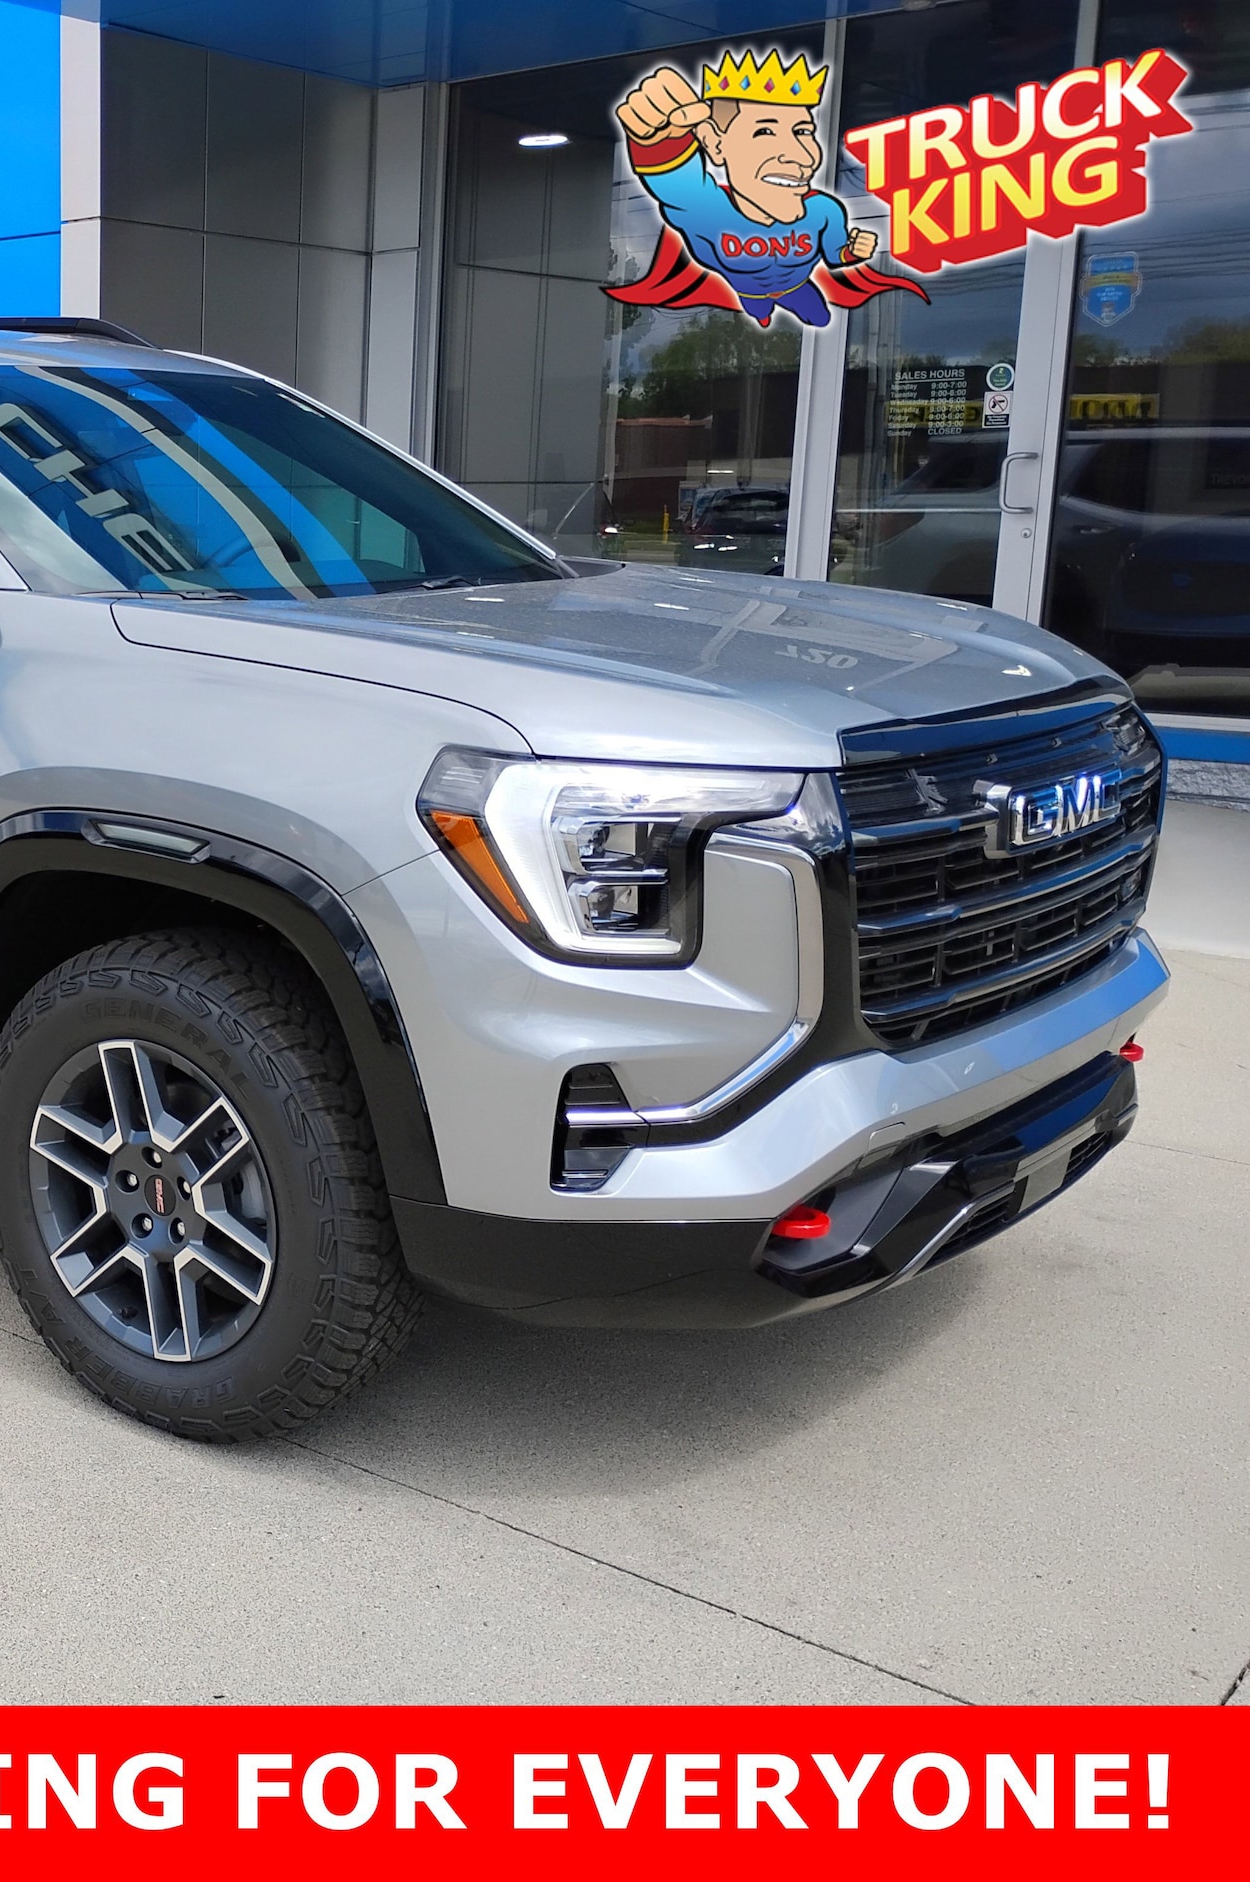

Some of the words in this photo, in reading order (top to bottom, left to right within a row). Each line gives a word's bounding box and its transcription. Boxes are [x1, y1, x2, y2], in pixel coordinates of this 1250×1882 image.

[890, 383, 918, 391] Monday
[895, 370, 928, 381] SALES
[929, 368, 966, 379] HOURS
[927, 427, 963, 436] CLOSED
[1011, 769, 1123, 846] GMC
[79, 996, 250, 1101] GENERAL
[63, 1336, 237, 1409] GRABBER
